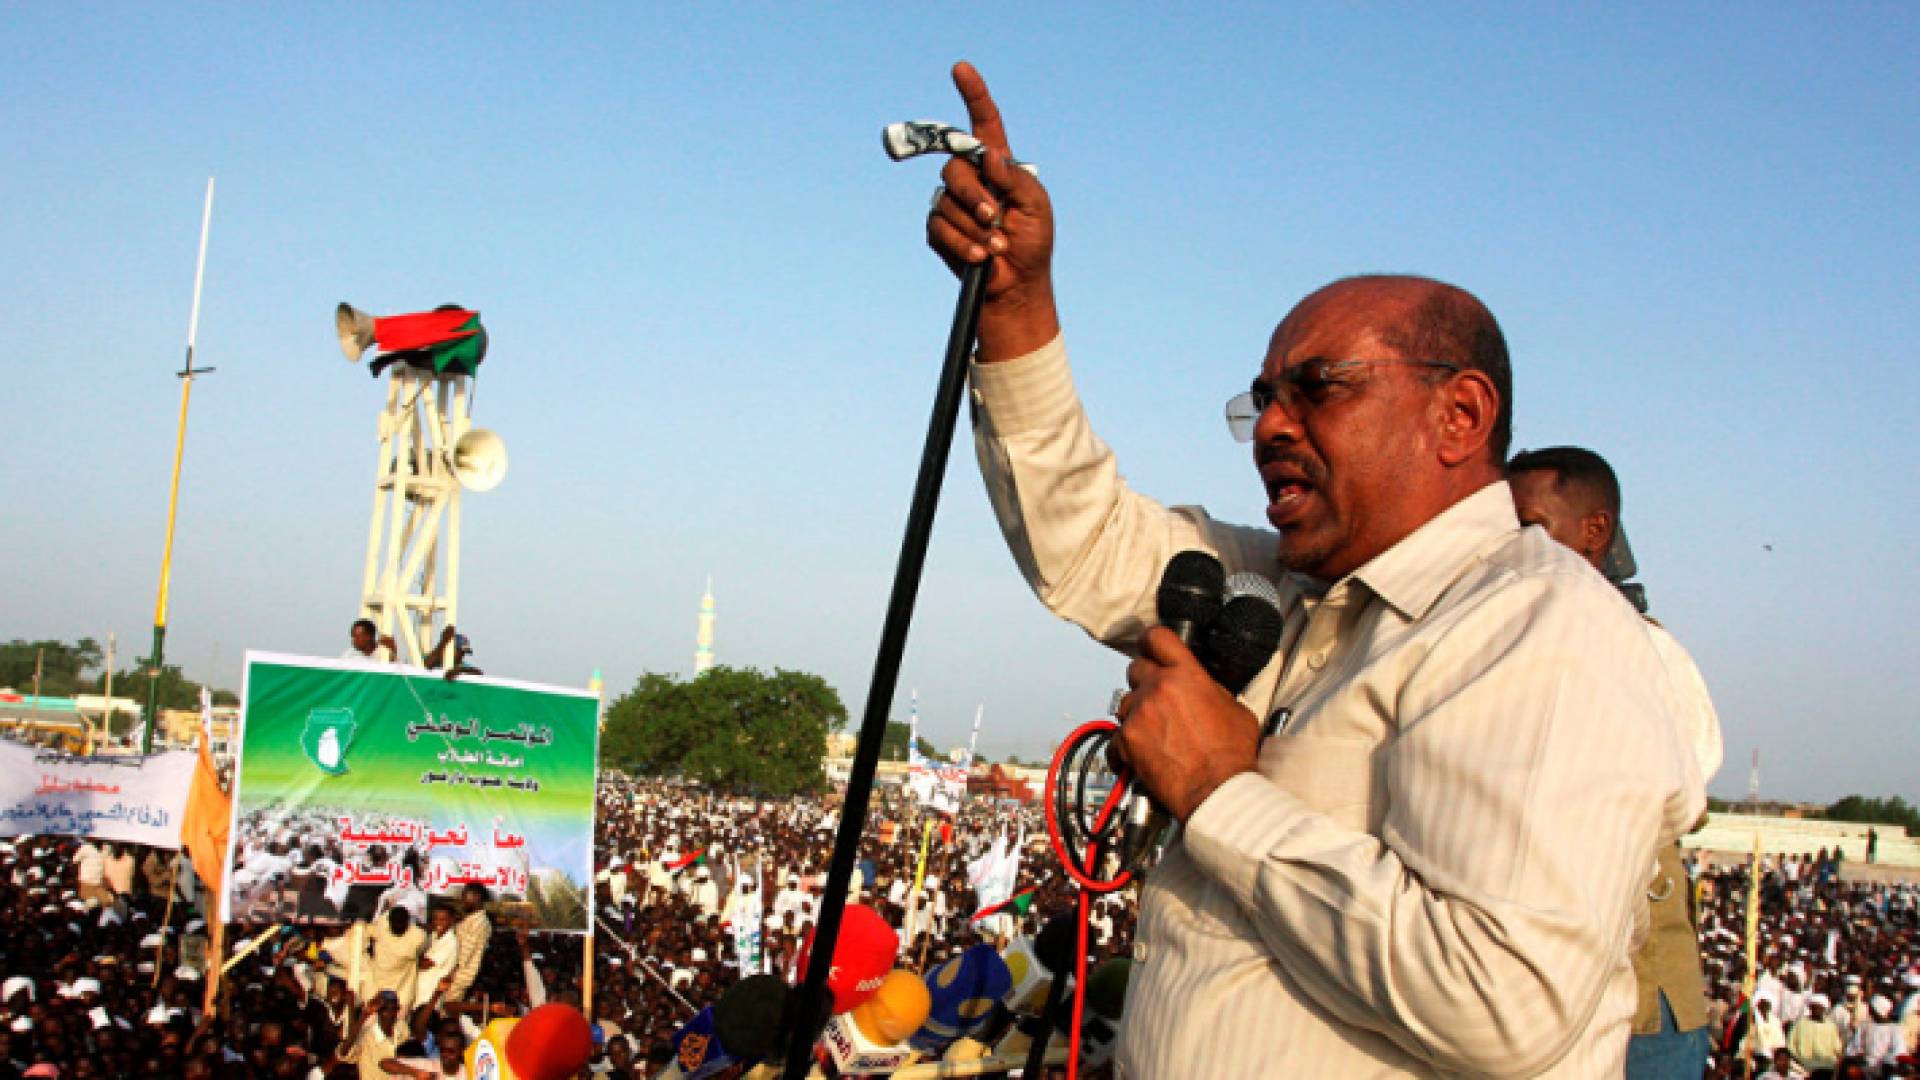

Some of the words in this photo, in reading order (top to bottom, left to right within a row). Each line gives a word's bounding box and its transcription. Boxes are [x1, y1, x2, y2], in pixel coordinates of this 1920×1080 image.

[338, 817, 424, 849] التنمية
[428, 822, 468, 851] نحو
[332, 863, 411, 888] والسلام
